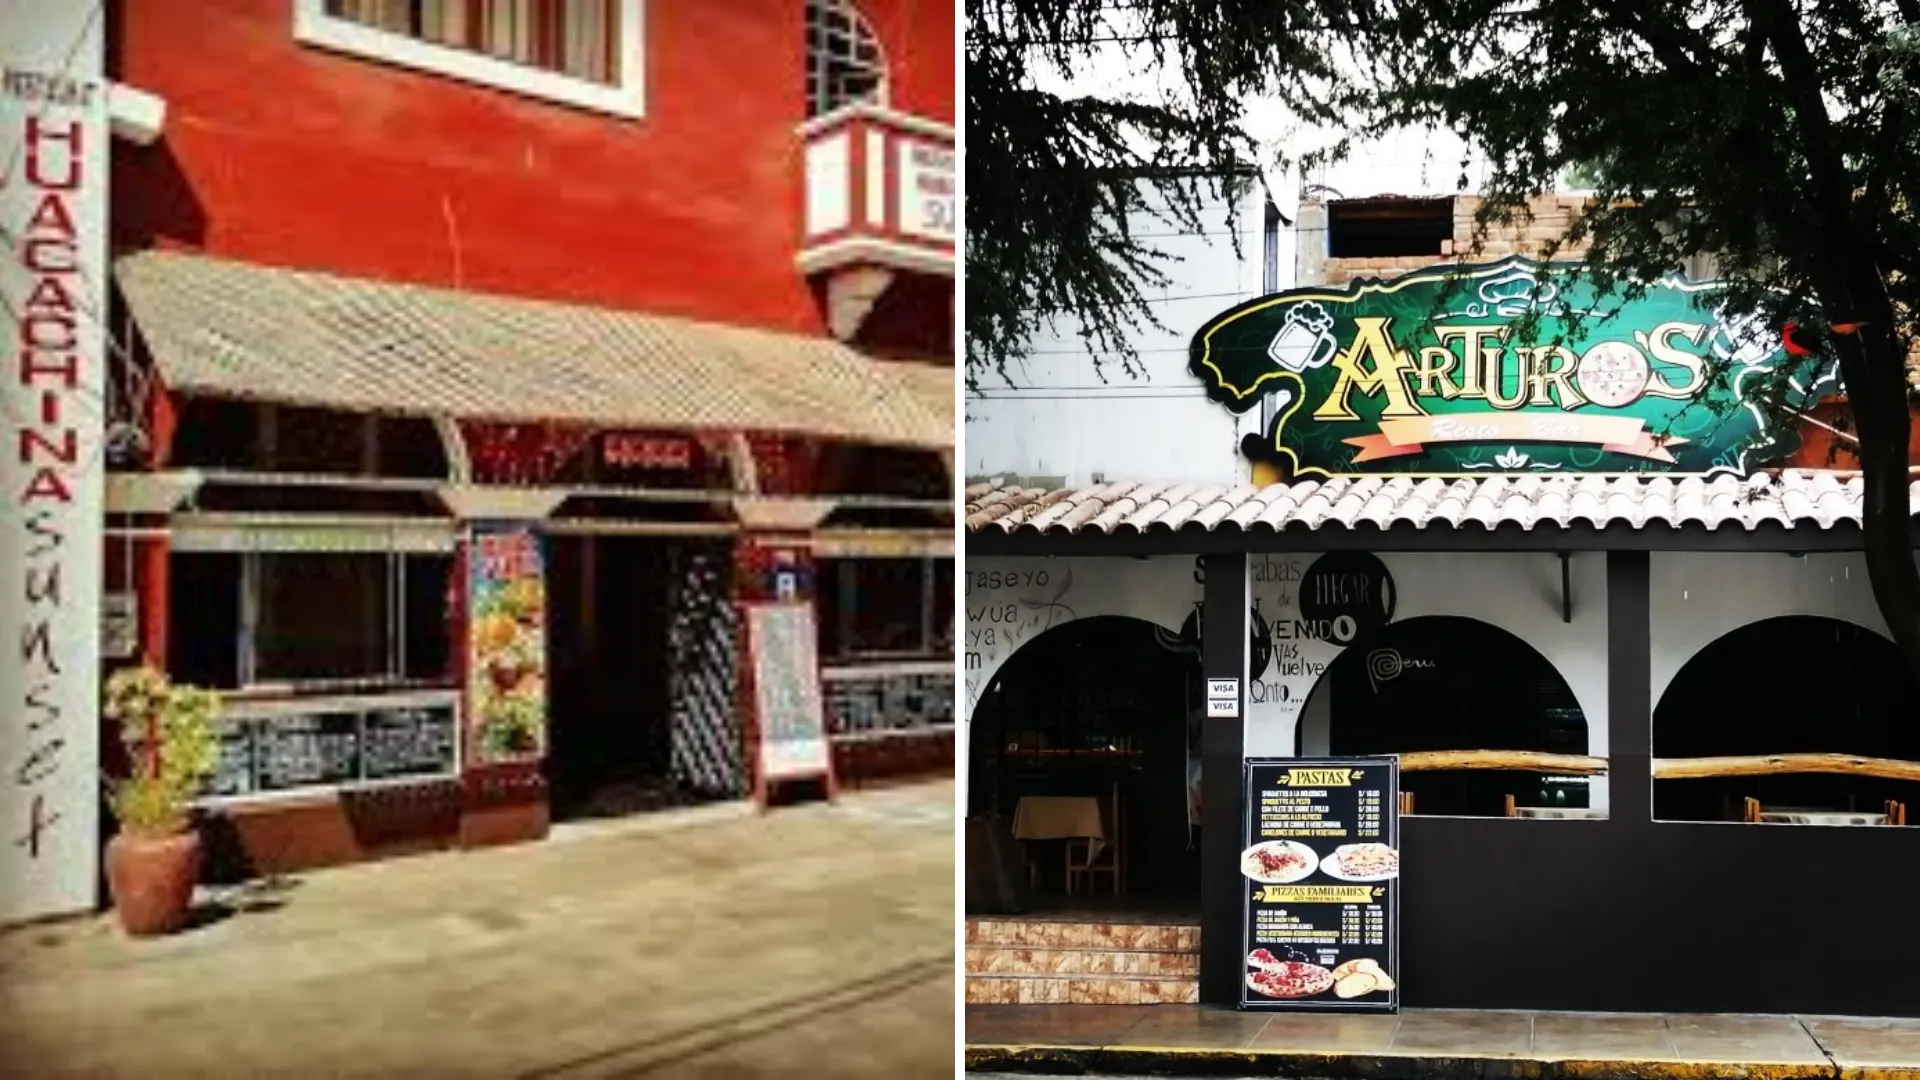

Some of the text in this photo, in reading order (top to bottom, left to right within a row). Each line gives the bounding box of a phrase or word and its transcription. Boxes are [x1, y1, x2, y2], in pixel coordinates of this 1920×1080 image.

[18, 115, 82, 505] HUACACHINA
[1213, 683, 1235, 693] VISA
[1213, 702, 1234, 710] VISA
[1296, 770, 1345, 785] PASTAS
[1272, 886, 1365, 897] PIZZAS FAMILIARES
